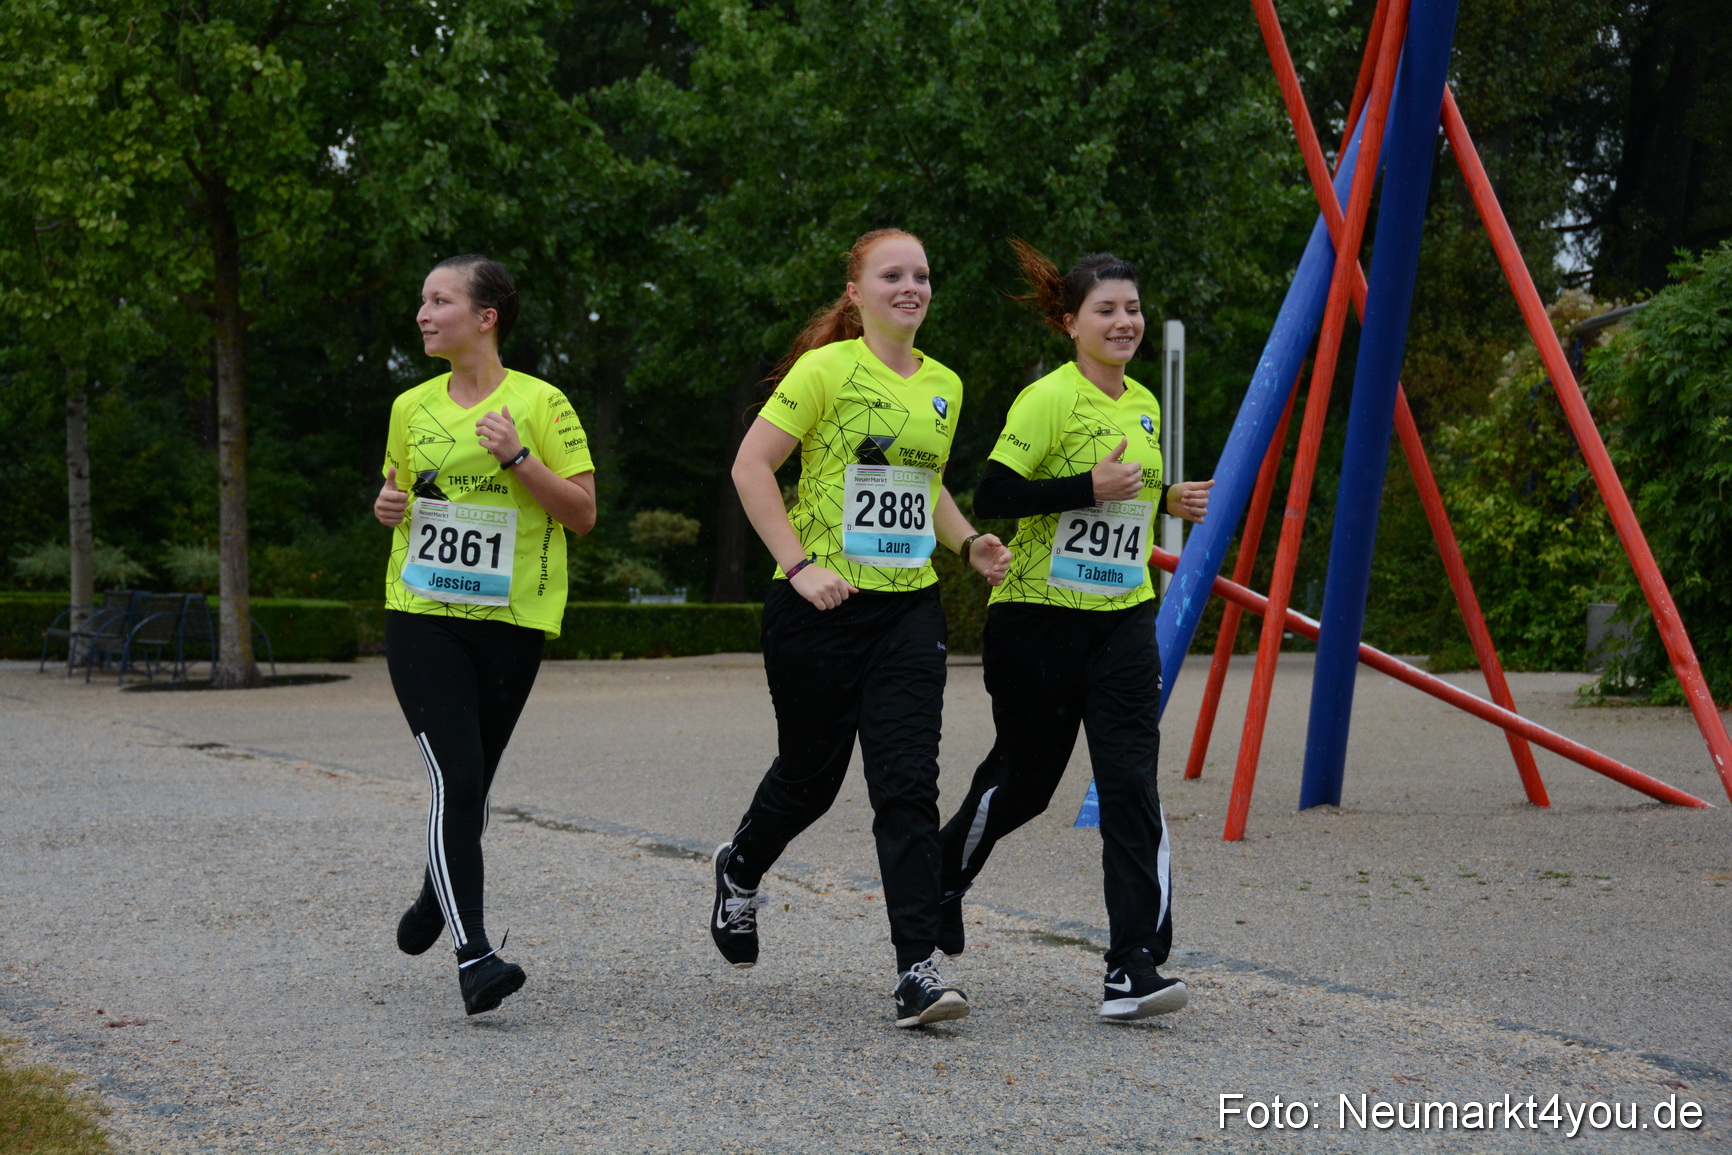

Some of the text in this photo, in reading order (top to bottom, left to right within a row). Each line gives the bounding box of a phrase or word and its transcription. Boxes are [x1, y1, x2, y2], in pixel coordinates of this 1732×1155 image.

[778, 392, 798, 410] Partl
[1007, 433, 1031, 452] Partl
[899, 447, 938, 462] THE NEXT
[916, 460, 941, 473] YEARS
[1142, 468, 1160, 478] NEXT
[448, 475, 469, 485] THE
[893, 470, 926, 484] BOCK
[473, 484, 508, 495] YEARS
[456, 506, 508, 524] BOCK
[854, 490, 926, 530] 2883
[1107, 502, 1146, 517] BOCK
[418, 523, 502, 569] 2861
[878, 538, 911, 554] Laura
[1064, 518, 1141, 561] 2914
[428, 572, 481, 592] Jessica
[1077, 563, 1124, 584] Tabatha
